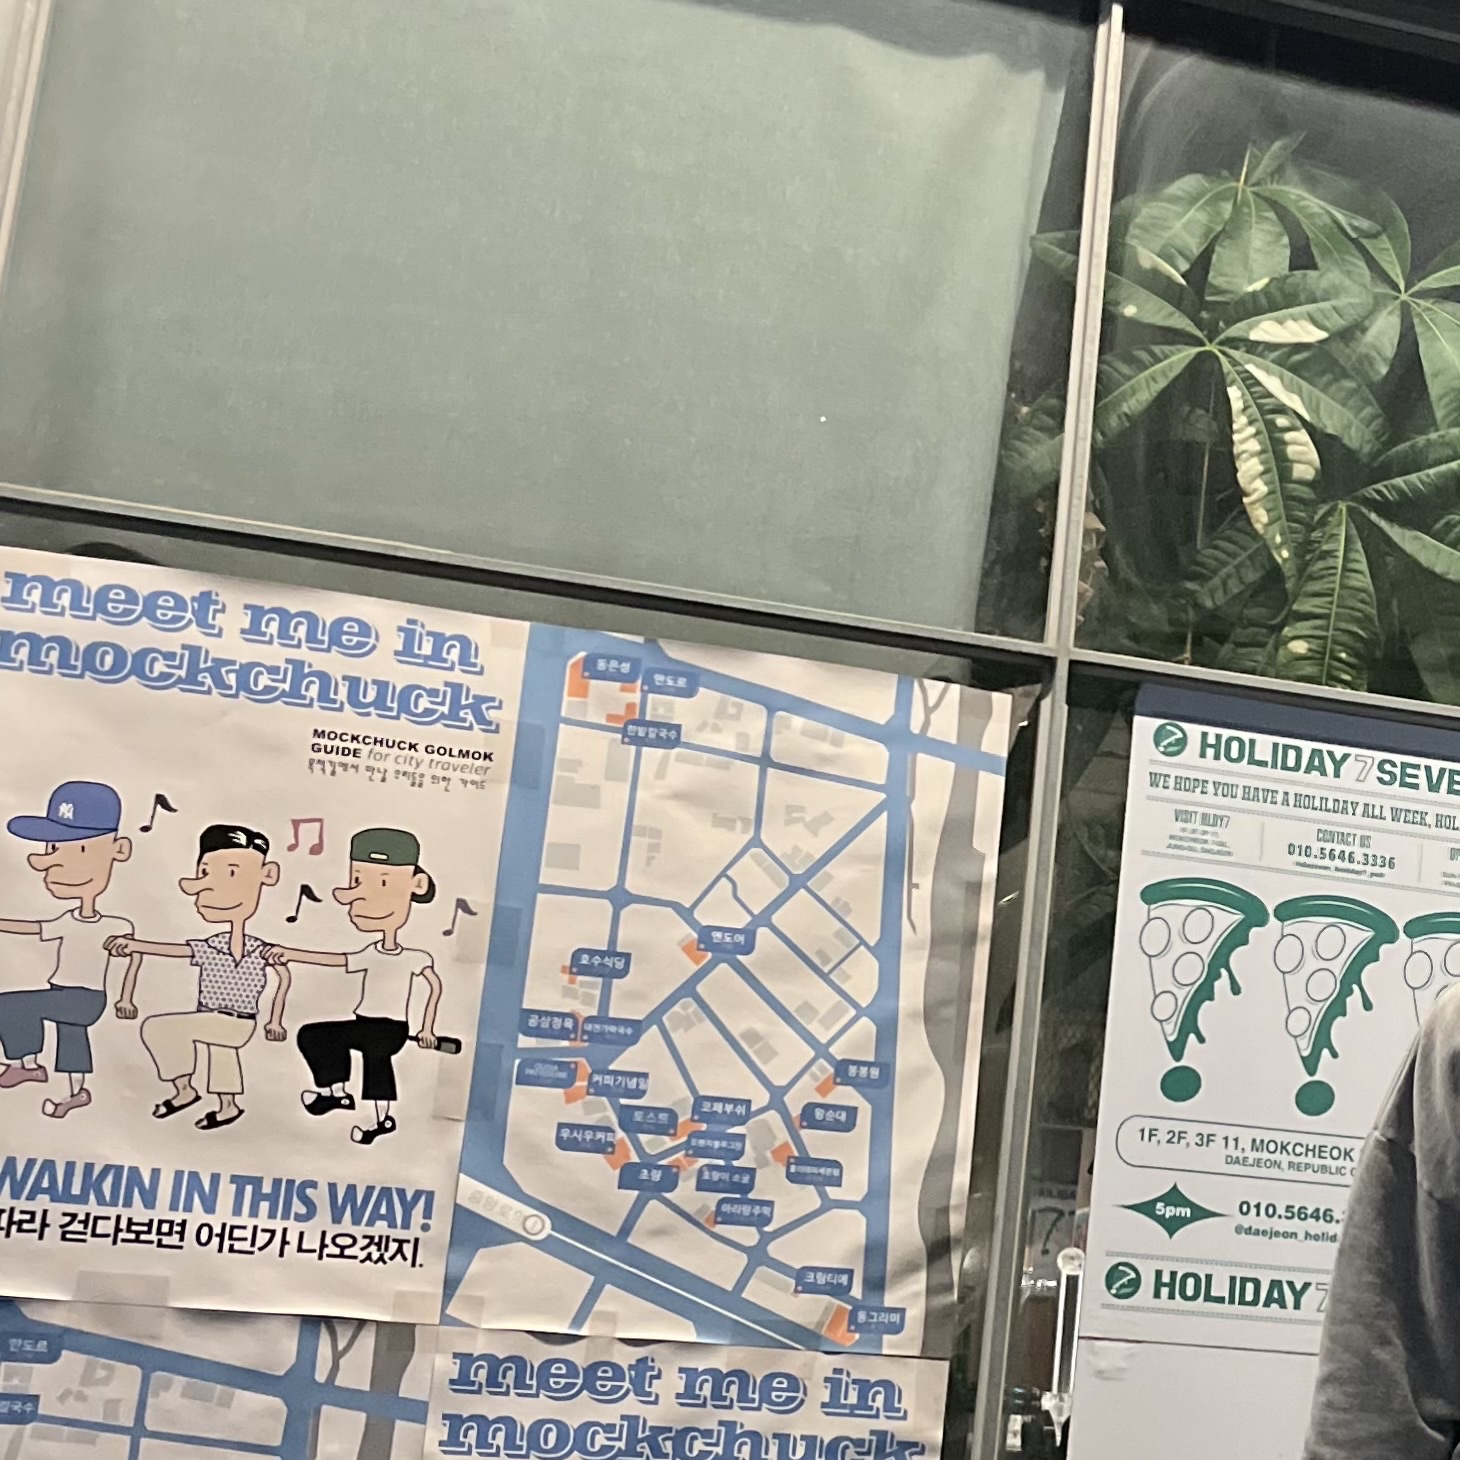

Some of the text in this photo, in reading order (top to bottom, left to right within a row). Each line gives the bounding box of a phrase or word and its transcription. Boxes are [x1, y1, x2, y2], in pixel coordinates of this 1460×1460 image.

[1, 571, 485, 675] meet me in
[0, 629, 503, 733] mockchuck
[311, 742, 492, 777] GUIDE for city traveler
[312, 728, 495, 762] MOCKCHUCK GOLMOK
[1149, 771, 1171, 790] WE
[1173, 775, 1209, 795] HOPE
[1212, 780, 1238, 799] YOU
[1242, 785, 1278, 806] HAVE
[1281, 791, 1290, 807] A
[1362, 802, 1386, 821] ALL
[1288, 842, 1396, 870] 010.5646.3336
[579, 953, 625, 970] 호수식당
[1138, 1127, 1355, 1163] 1F, 2F, 3F 11, MOKCHEOK
[1224, 1154, 1285, 1173] DAEJEON,
[1287, 1160, 1347, 1177] REPUBLIC
[0, 1155, 162, 1210] WALKIN
[169, 1170, 221, 1217] IN
[229, 1174, 319, 1223] THIS
[327, 1181, 437, 1233] WAY!
[1155, 1201, 1191, 1220] 5pm
[58, 1211, 187, 1250] 걷다보면
[195, 1221, 290, 1259] 어딘가
[296, 1230, 425, 1269] 나오겠지.
[448, 1351, 907, 1421] meet me in
